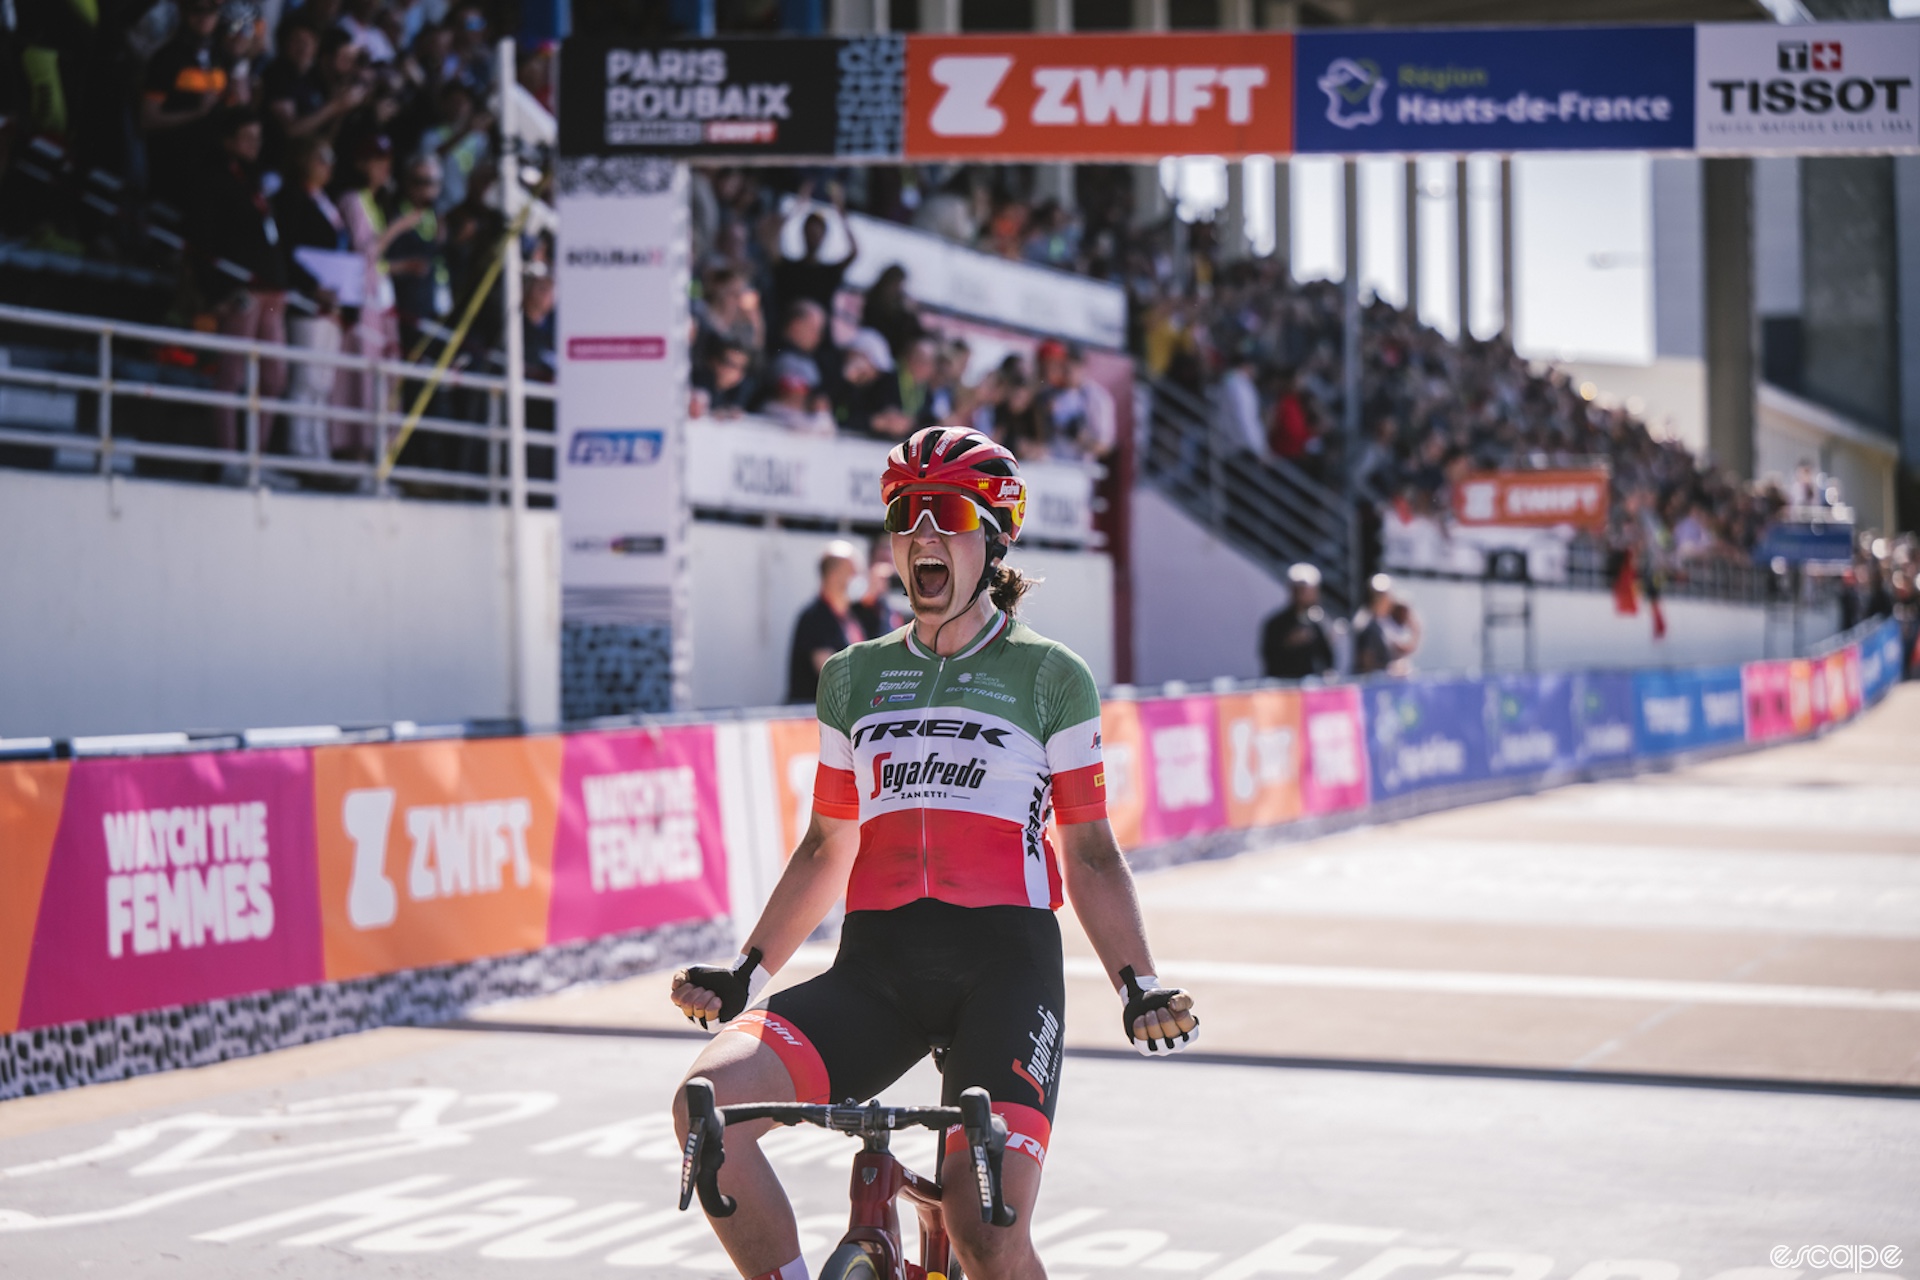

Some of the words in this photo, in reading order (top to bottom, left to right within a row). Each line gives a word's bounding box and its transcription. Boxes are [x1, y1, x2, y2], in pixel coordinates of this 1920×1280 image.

[606, 49, 727, 83] PARIS
[1399, 65, 1487, 91] Région
[606, 85, 792, 120] ROUBAIX
[1031, 67, 1267, 126] ZWIFT
[1397, 92, 1673, 126] Hauts-de-France
[1708, 76, 1912, 114] TISSOT
[875, 680, 921, 692] Santini
[880, 670, 923, 678] SRAM
[944, 686, 1016, 705] BONTRAGER
[852, 719, 1012, 750] TREK
[582, 771, 655, 820] WATCH
[657, 765, 698, 814] THE
[870, 752, 987, 800] Segafredo
[900, 791, 947, 799] ZANETTI
[103, 808, 207, 873] WATCH
[211, 802, 268, 862] THE
[405, 797, 531, 901] ZWIFT
[586, 817, 704, 894] FEMMES
[107, 861, 275, 960] FEMMES
[1012, 1008, 1060, 1106] Segafredo
[973, 1144, 993, 1208] SRAM
